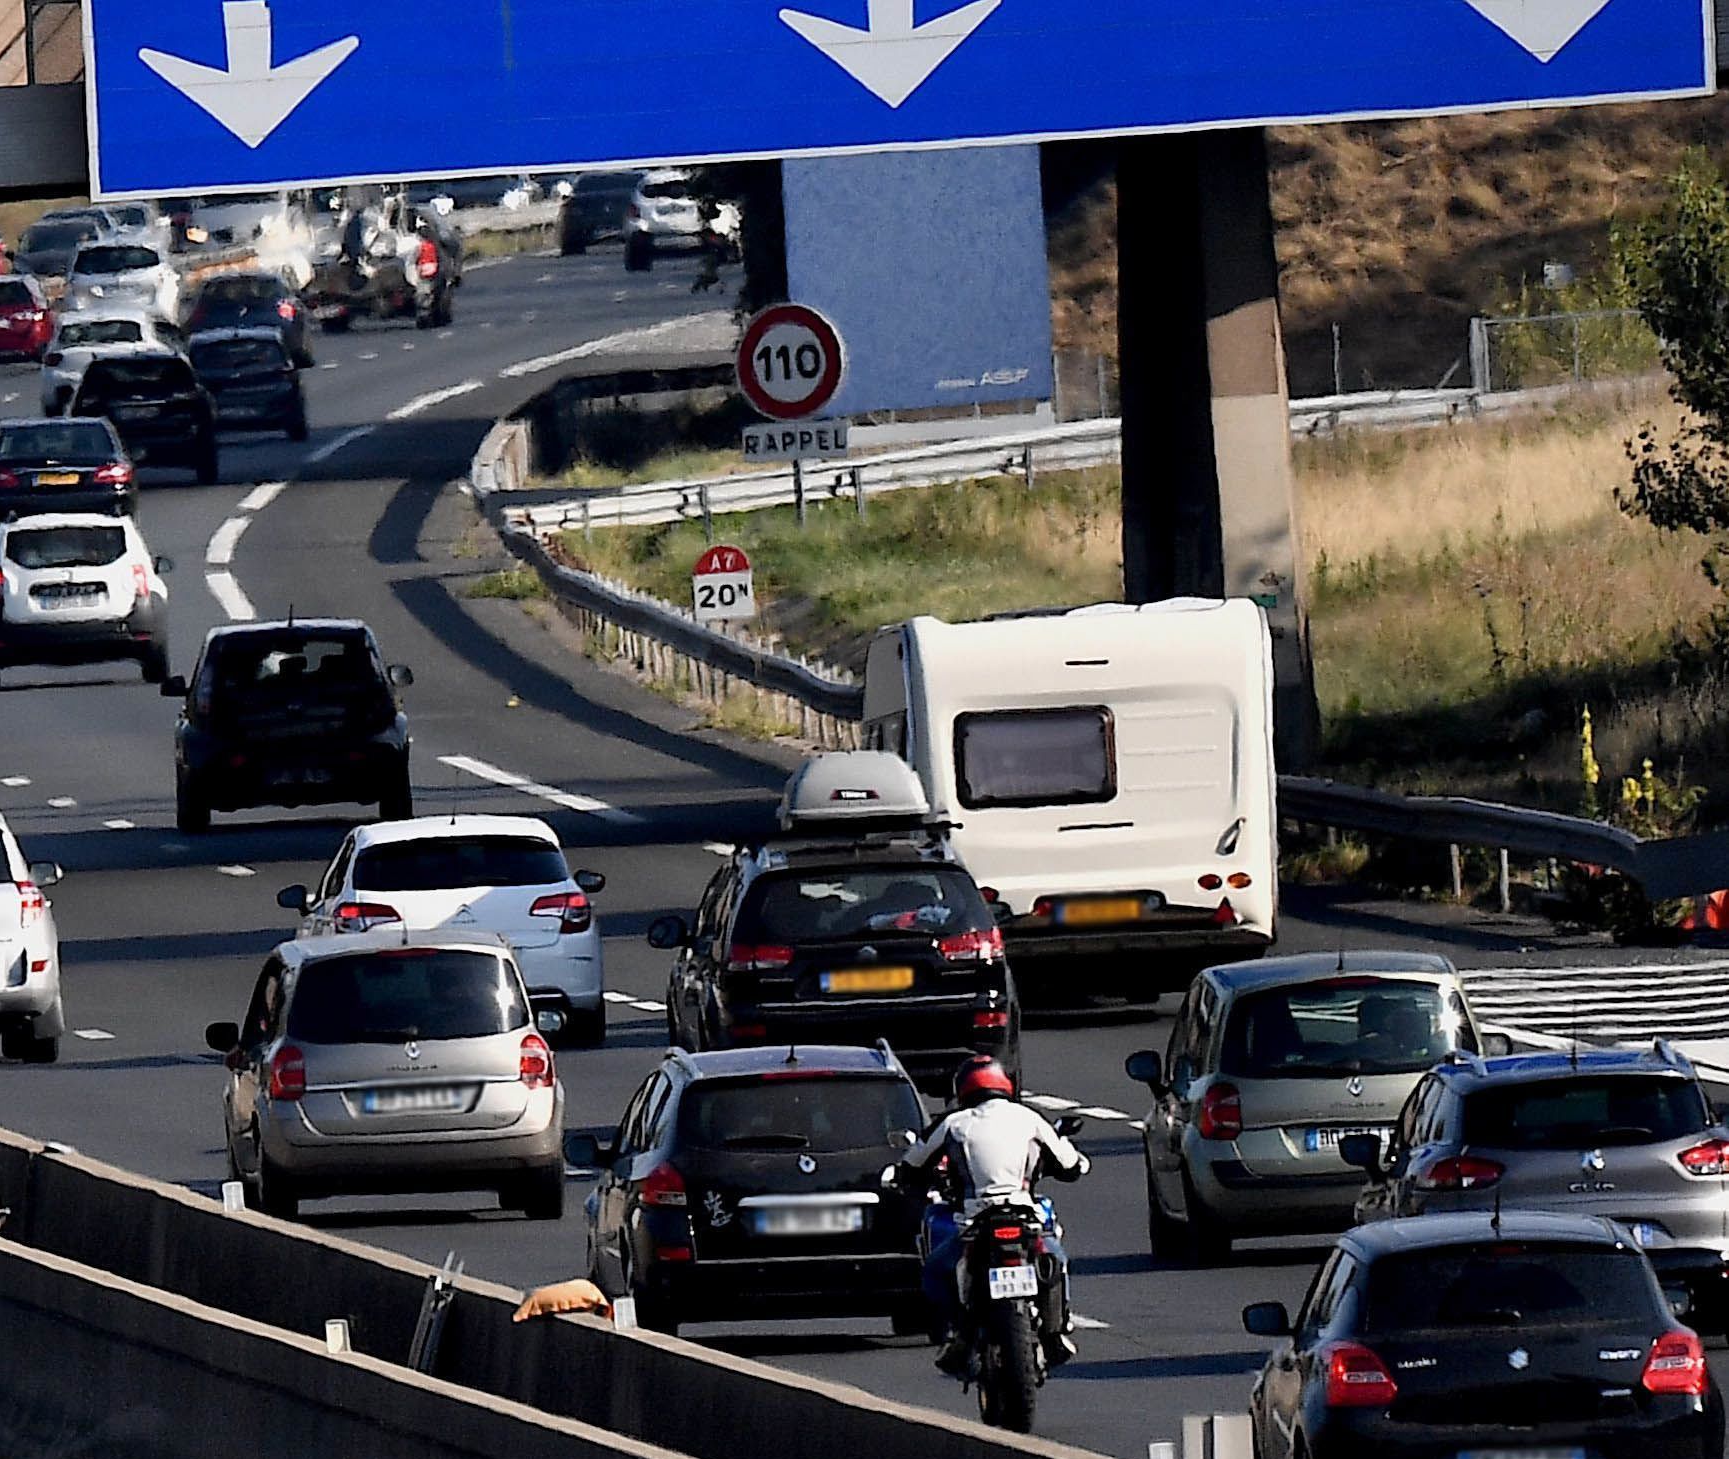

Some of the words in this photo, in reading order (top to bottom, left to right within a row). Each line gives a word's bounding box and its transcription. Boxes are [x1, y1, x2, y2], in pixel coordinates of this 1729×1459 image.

[757, 344, 820, 382] 110
[745, 429, 846, 454] RAPPEL
[710, 553, 737, 572] A7
